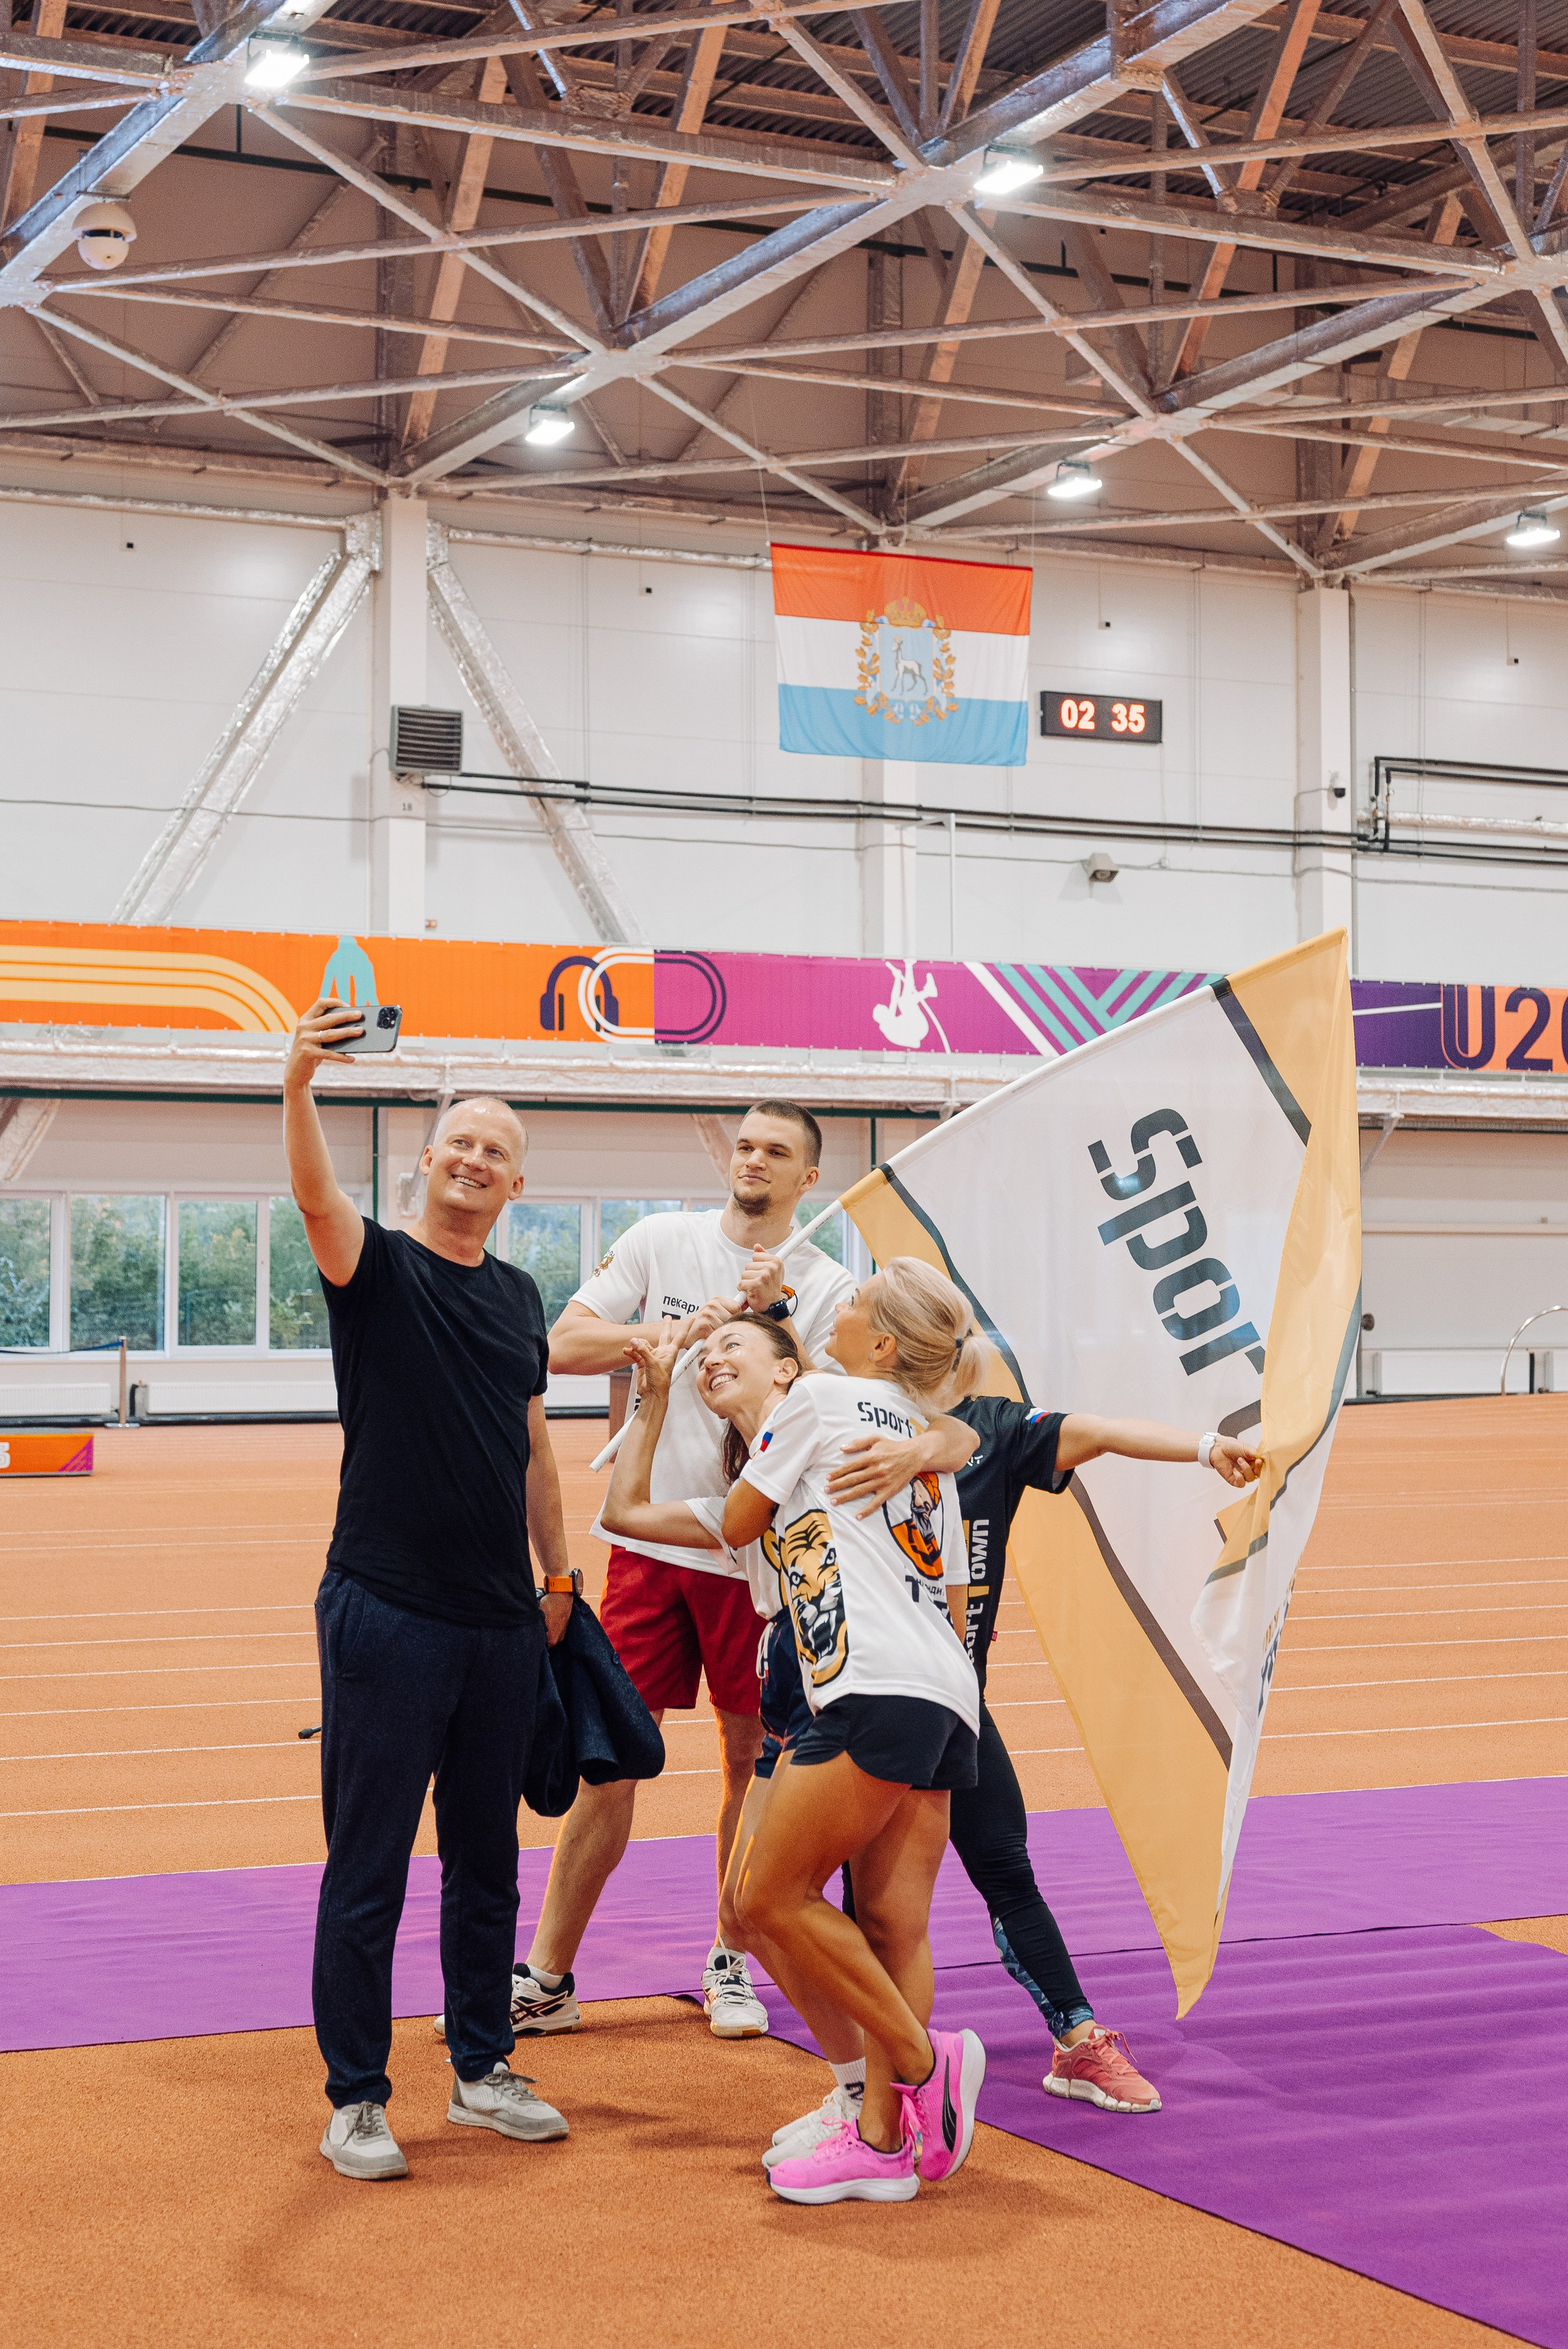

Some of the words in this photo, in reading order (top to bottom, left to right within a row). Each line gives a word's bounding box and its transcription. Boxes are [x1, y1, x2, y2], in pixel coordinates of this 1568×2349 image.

[1060, 699, 1095, 730] 02
[1110, 703, 1146, 734] 35
[1439, 982, 1568, 1072] U2
[1087, 1108, 1265, 1439] Spor
